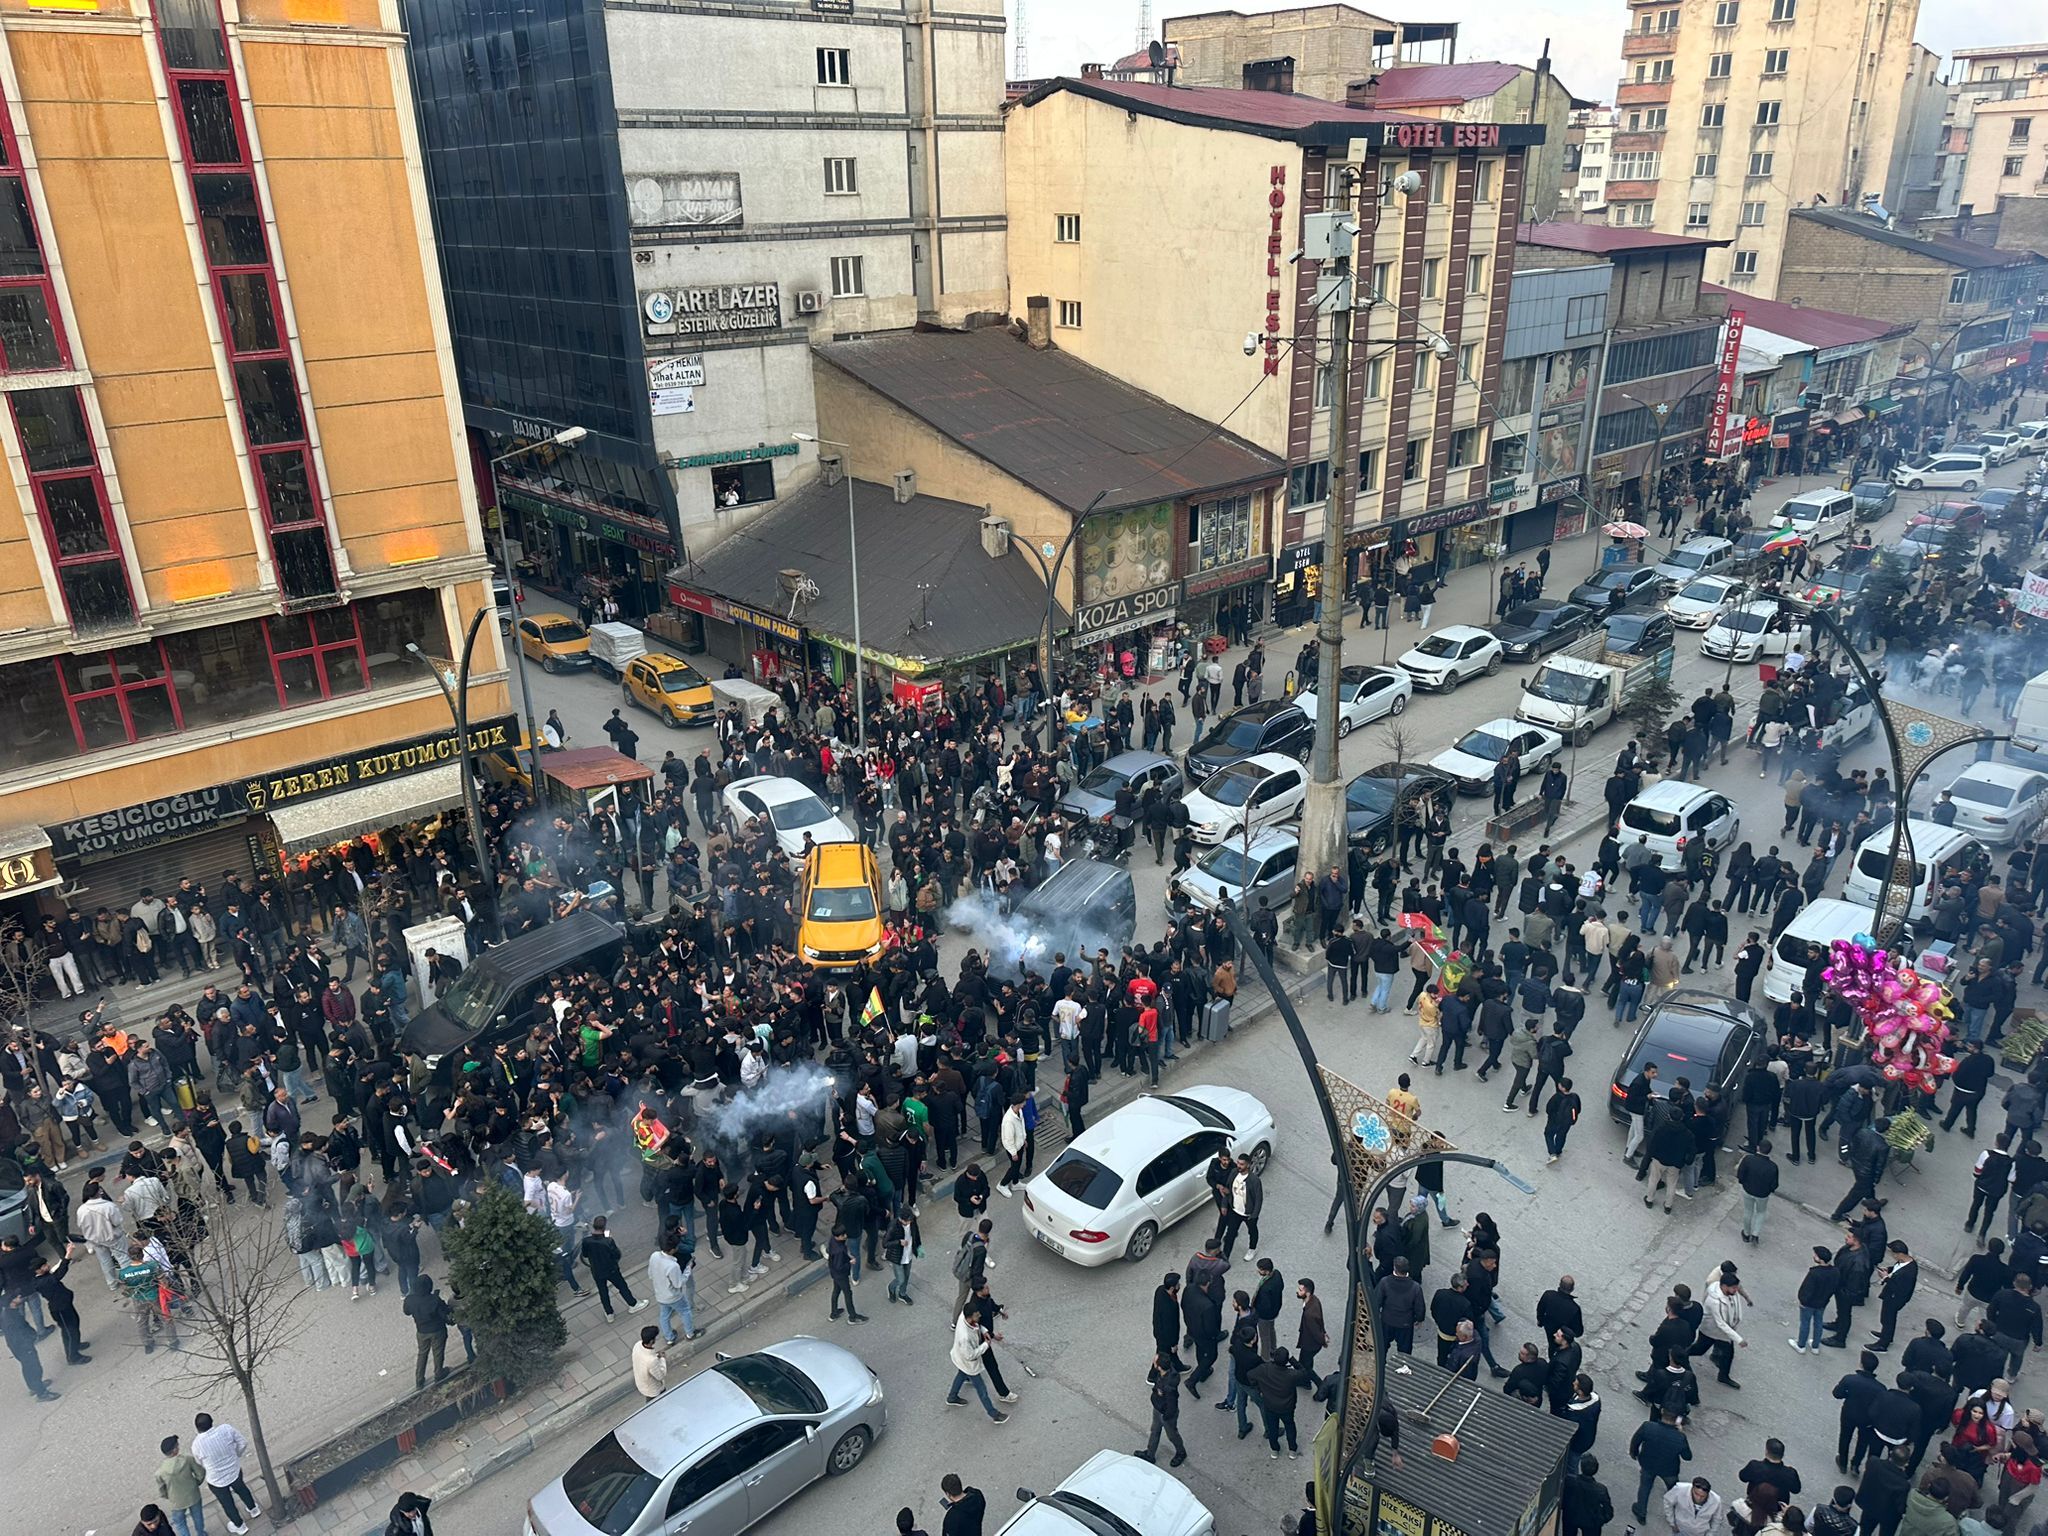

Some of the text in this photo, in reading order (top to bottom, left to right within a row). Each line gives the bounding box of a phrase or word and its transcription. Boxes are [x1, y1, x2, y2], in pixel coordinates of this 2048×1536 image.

[1453, 125, 1500, 147] ESEN
[1264, 166, 1286, 376] HOTEL ESEN
[674, 285, 779, 314] ART LAZER
[720, 315, 730, 330] &
[676, 370, 702, 380] ALTAN
[1709, 317, 1741, 449] HOTEL ARSLAN
[512, 419, 542, 441] BAJAR
[1295, 558, 1310, 569] ESEN
[1296, 547, 1311, 558] OTEL
[1078, 585, 1179, 632] KOZA SPOT
[729, 605, 752, 624] ROYAL
[772, 620, 799, 641] PAZARI
[1080, 620, 1145, 646] KOZA SPOT
[270, 764, 351, 800] ZEREN
[76, 807, 219, 855] KUYUMCULUK
[1702, 857, 1713, 867] 21
[1582, 880, 1592, 889] 21
[906, 1111, 917, 1125] 21
[1393, 1099, 1407, 1115] 21
[1380, 1499, 1422, 1529] DİZE TAKSİ
